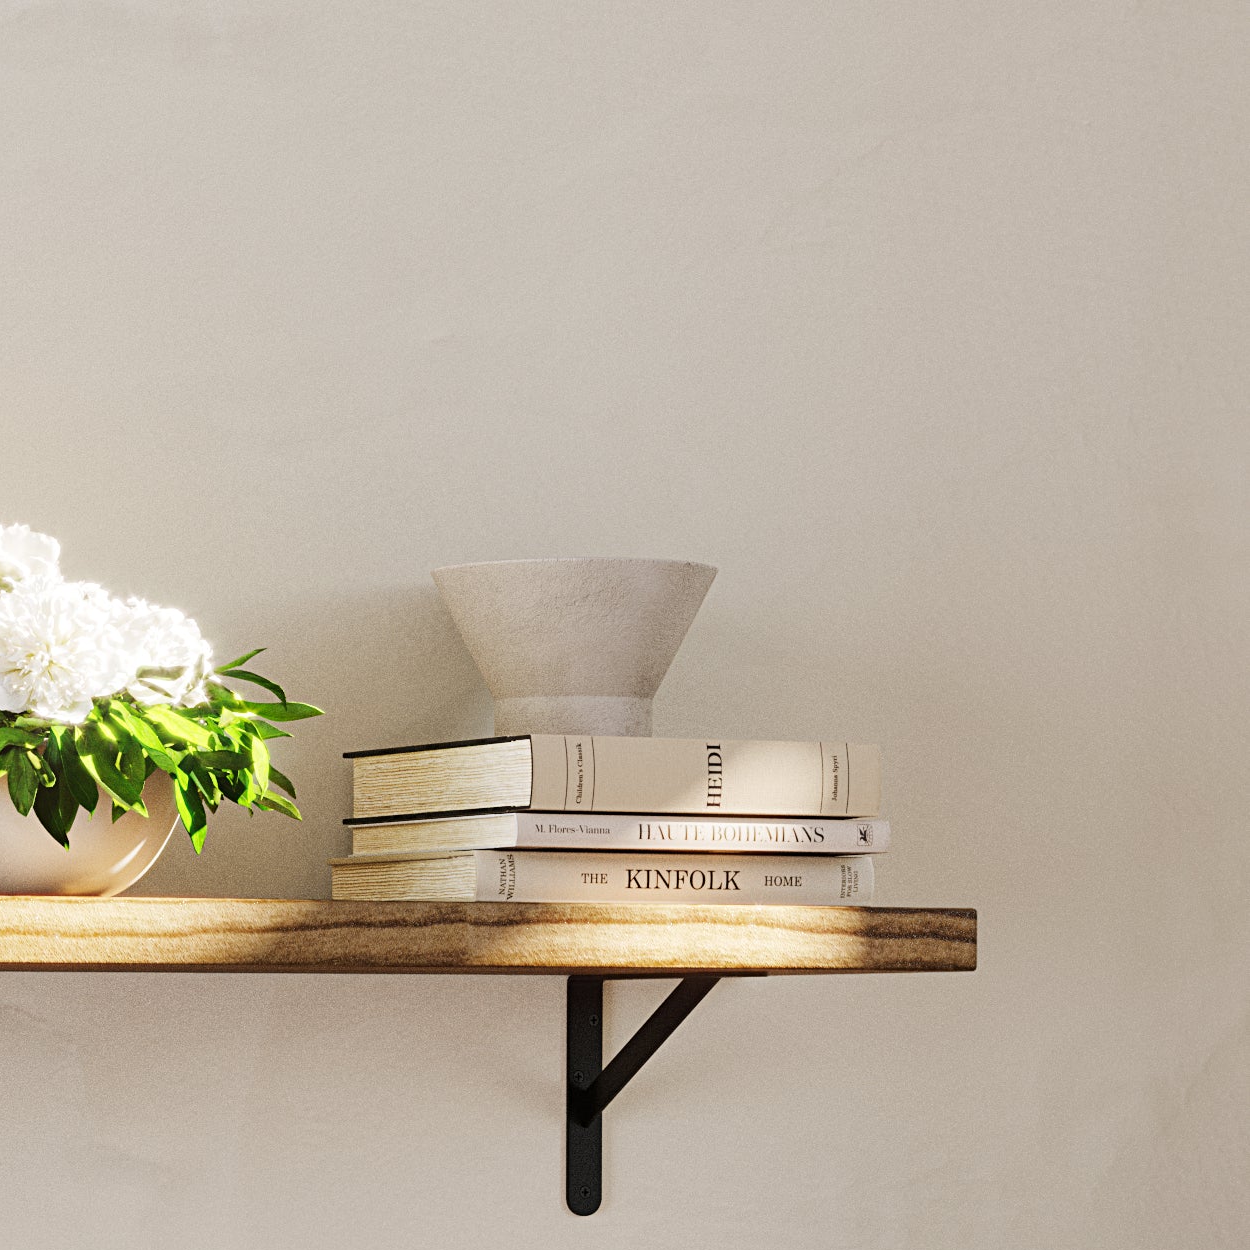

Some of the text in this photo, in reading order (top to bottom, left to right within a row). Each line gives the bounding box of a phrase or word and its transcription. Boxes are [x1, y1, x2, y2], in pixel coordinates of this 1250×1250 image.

[575, 768, 584, 804] Children's
[706, 742, 723, 808] HEIDI
[831, 755, 840, 801] Johanna Spyri
[535, 824, 611, 835] M. Flores-Vianna
[638, 823, 825, 844] HAUTE BOHEMIANS
[498, 858, 506, 895] NATHAN
[507, 853, 516, 900] WILLIAMS
[581, 868, 802, 891] THE KINFOLK HOME
